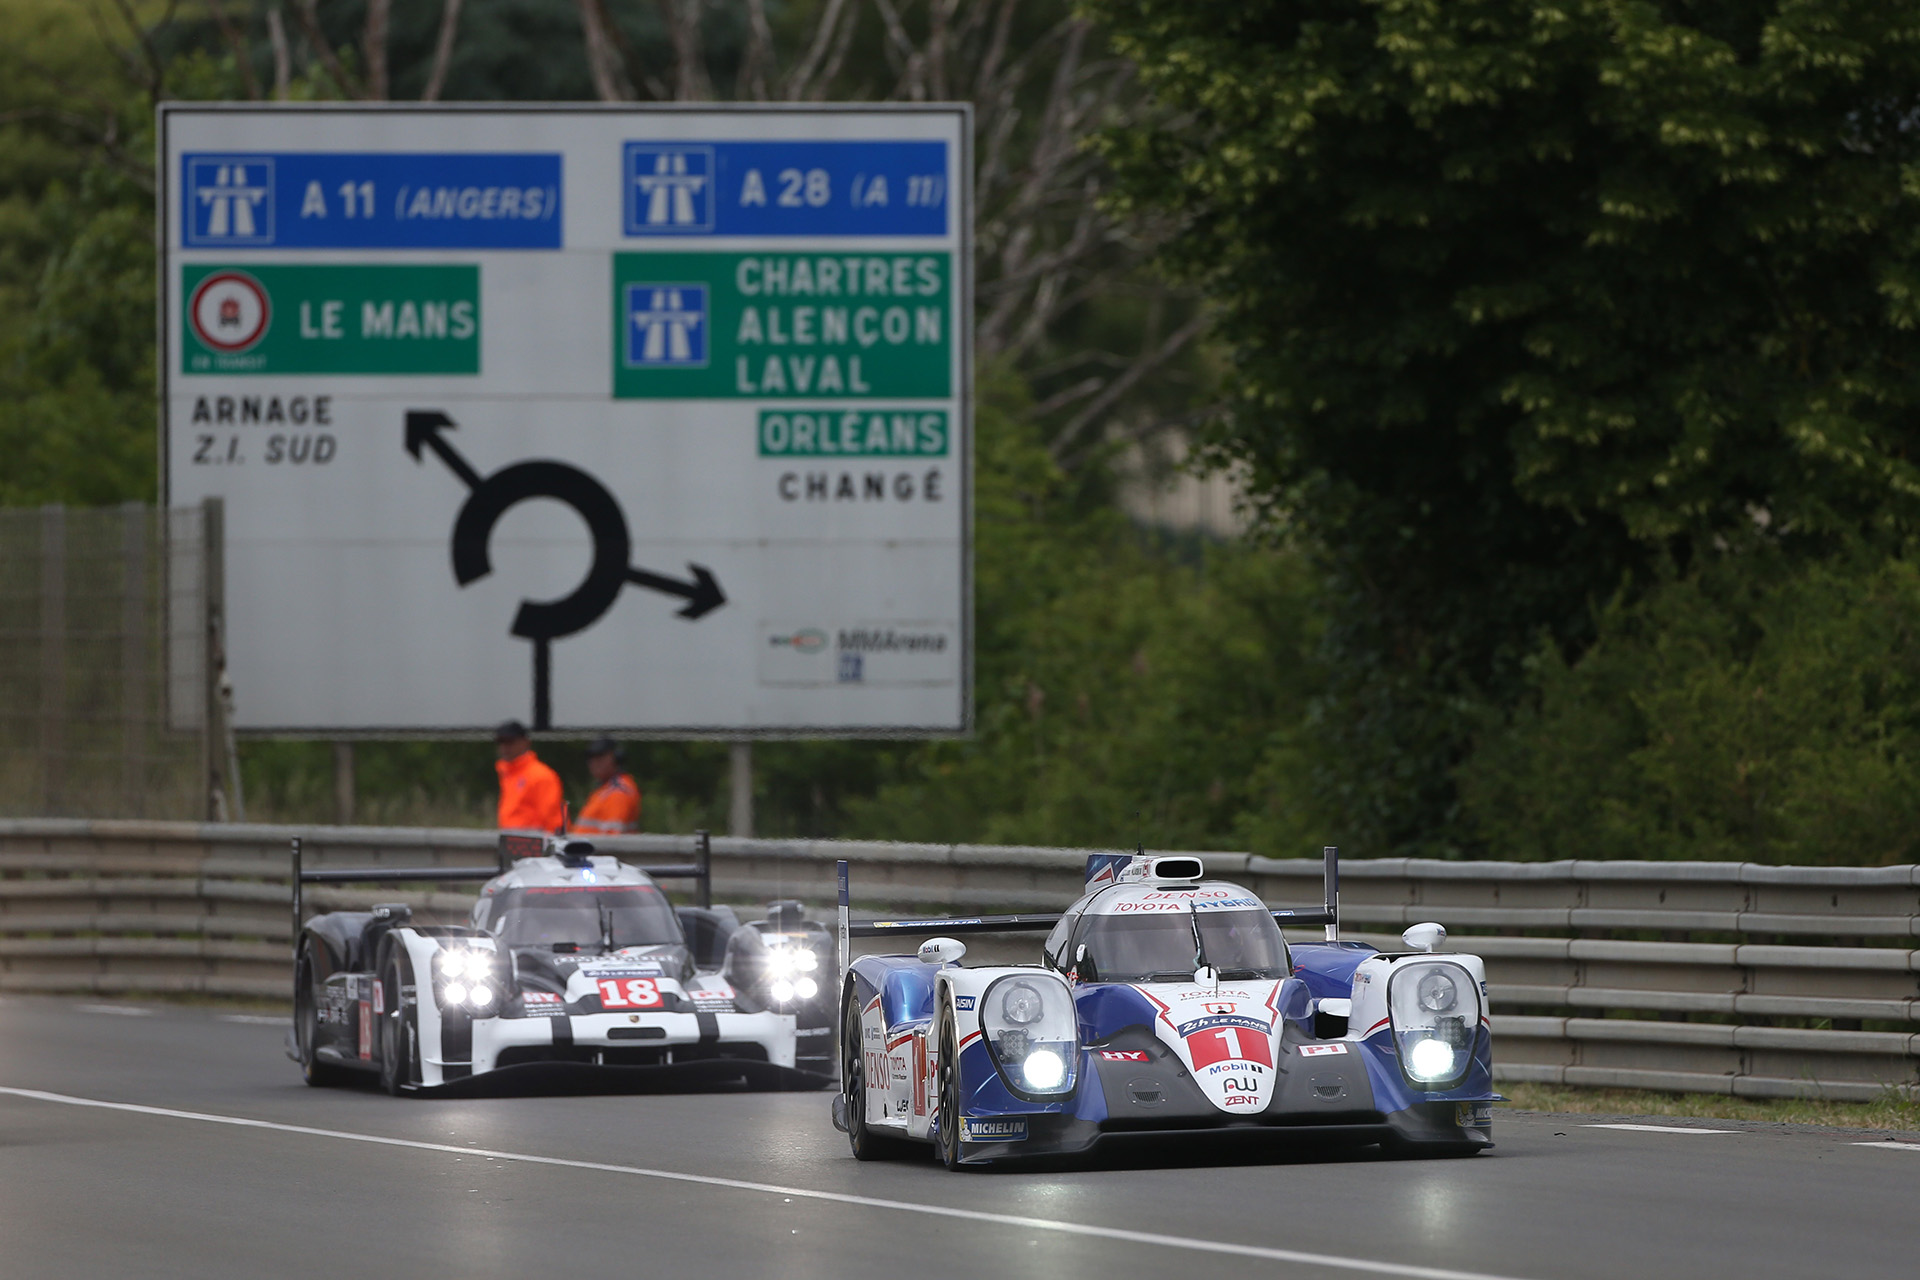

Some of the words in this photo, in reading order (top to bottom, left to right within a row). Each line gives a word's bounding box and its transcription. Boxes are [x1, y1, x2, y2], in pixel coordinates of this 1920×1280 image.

[300, 180, 327, 219] A
[338, 180, 377, 219] 11
[395, 185, 557, 222] (ANGERS)
[739, 168, 768, 207] A
[776, 168, 831, 207] 28
[850, 172, 889, 209] (A
[735, 257, 941, 297] CHARTRES
[300, 301, 344, 340] LE
[361, 300, 477, 340] MANS
[736, 305, 942, 348] ALENÇON
[736, 354, 870, 394] LAVAL
[192, 395, 333, 425] ARNAGE
[763, 410, 944, 453] ORLÉANS
[192, 434, 246, 466] Z.I.
[264, 434, 338, 466] SUD
[778, 466, 943, 502] CHANGÉ
[1114, 902, 1180, 913] TOYOTA
[1189, 898, 1258, 909] HYBRID
[1143, 890, 1229, 901] DENSO
[523, 992, 557, 1002] HY
[600, 979, 660, 1007] 18
[1230, 1018, 1268, 1031] MANS
[1102, 1051, 1142, 1060] HY
[1214, 1028, 1243, 1059] 1
[1306, 1045, 1339, 1054] P1
[866, 1051, 890, 1090] DENSO
[1209, 1063, 1248, 1075] Mobil
[1225, 1095, 1259, 1106] ZENT
[971, 1122, 1025, 1134] MICHELIN
